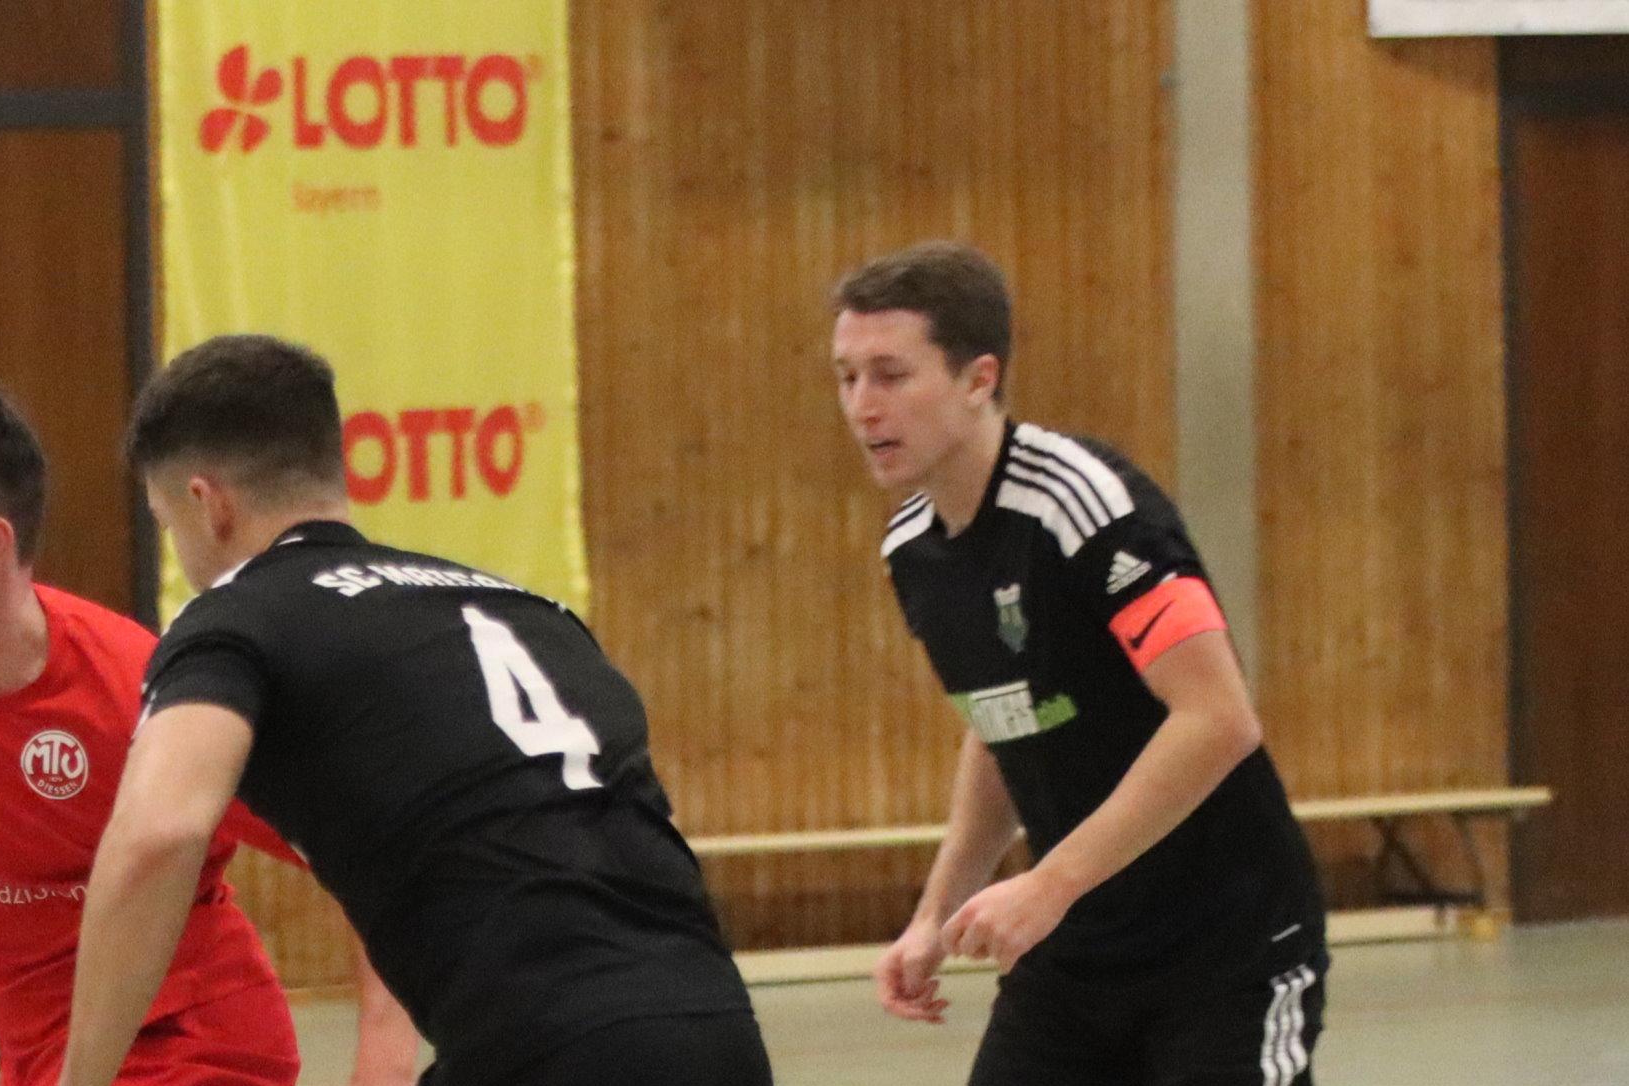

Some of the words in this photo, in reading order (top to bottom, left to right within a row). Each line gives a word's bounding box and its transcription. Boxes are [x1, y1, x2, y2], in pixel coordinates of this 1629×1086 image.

[293, 54, 527, 149] LOTTO
[342, 404, 524, 505] OTTO
[461, 606, 603, 790] 4
[37, 779, 78, 795] DIESSEN
